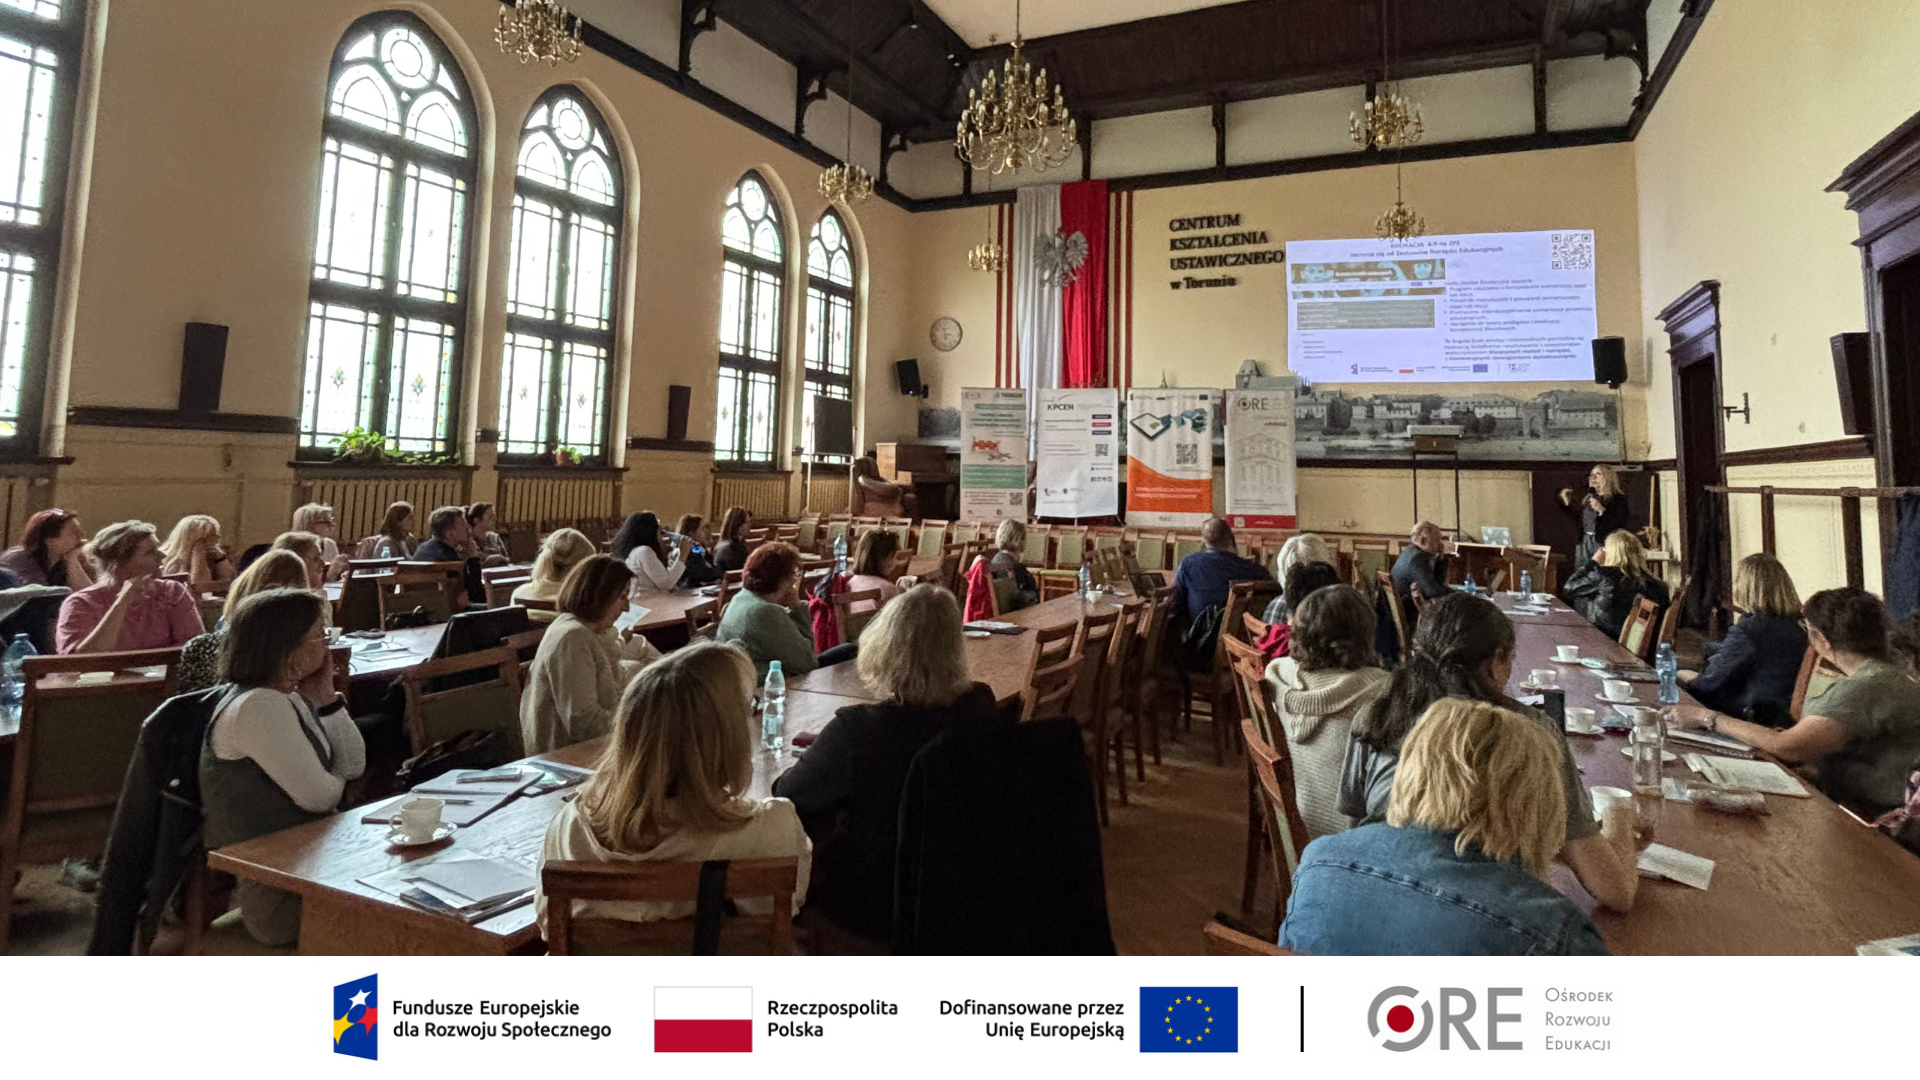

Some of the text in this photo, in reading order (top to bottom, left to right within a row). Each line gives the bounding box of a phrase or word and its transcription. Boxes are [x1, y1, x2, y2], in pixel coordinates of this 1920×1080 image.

[1169, 214, 1241, 232] CENTRUM
[1169, 250, 1285, 271] USTAWICZNEGO
[1169, 275, 1237, 290] w Toruniu
[1047, 403, 1074, 411] KPCEN
[1237, 397, 1270, 411] ORE
